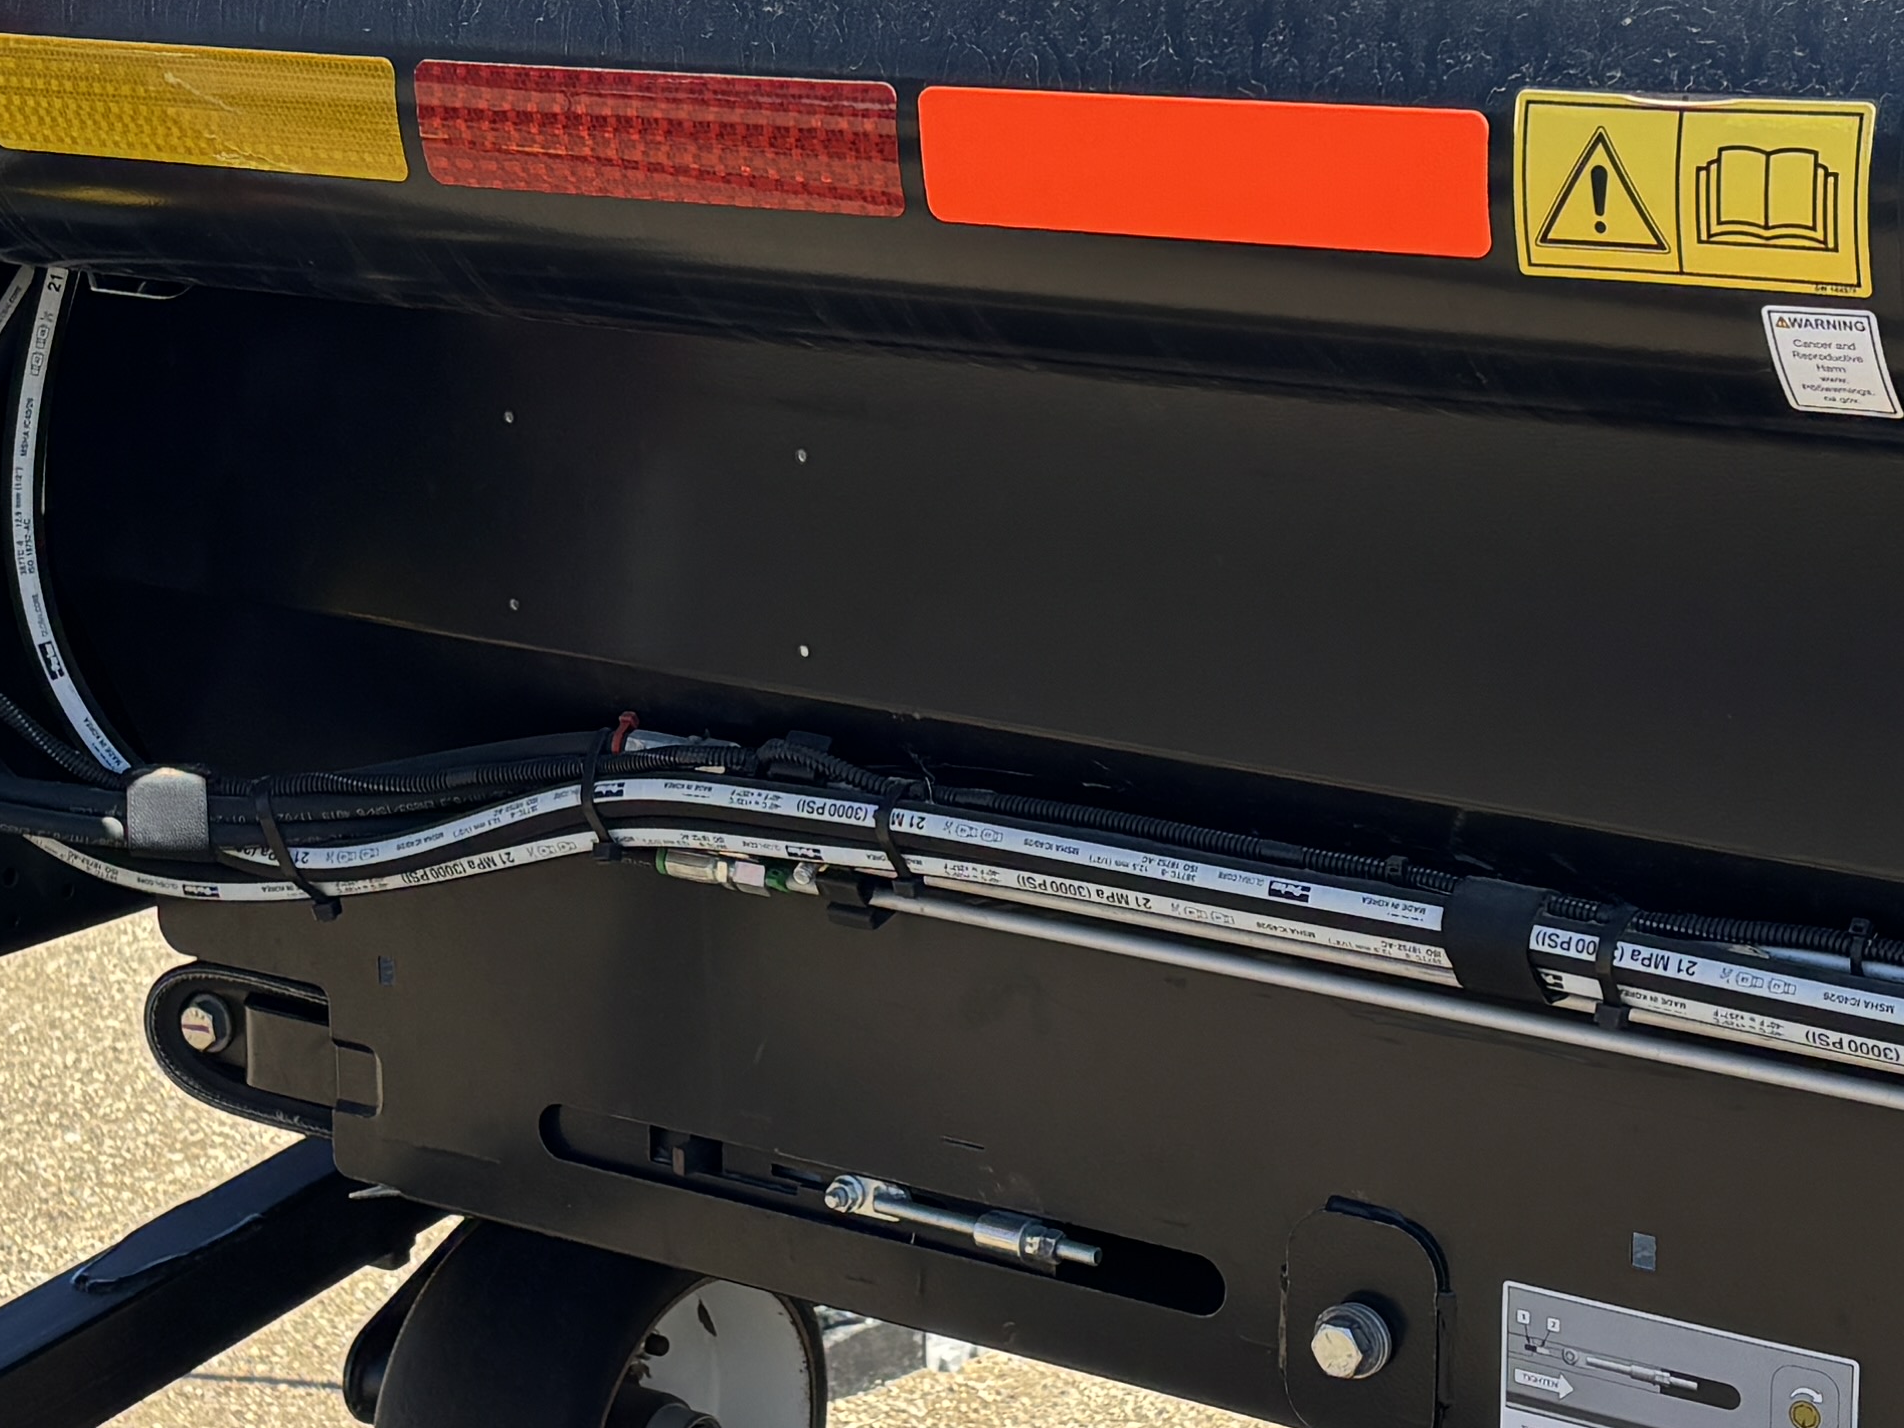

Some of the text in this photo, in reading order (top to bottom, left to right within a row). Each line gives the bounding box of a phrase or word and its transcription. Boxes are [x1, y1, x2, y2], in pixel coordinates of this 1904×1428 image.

[1788, 317, 1866, 332] WARNING
[1793, 339, 1856, 351] Cancer and
[794, 797, 826, 817] PSI)
[826, 800, 868, 822] (3000
[907, 813, 926, 831] 21
[293, 850, 309, 864] 21
[399, 853, 515, 887] 21 MPa (3000 PSI)
[1013, 872, 1048, 892] PSI)
[1047, 877, 1093, 900] (3000
[1092, 886, 1130, 906] MPa
[1133, 894, 1152, 910] 21
[1360, 894, 1390, 909] KOREA
[1400, 902, 1426, 915] MADE
[1532, 928, 1698, 976] 21 MPa PSI)
[1861, 997, 1895, 1013] MSHA
[1802, 1028, 1845, 1050] PSI)
[1845, 1037, 1902, 1062] (3000
